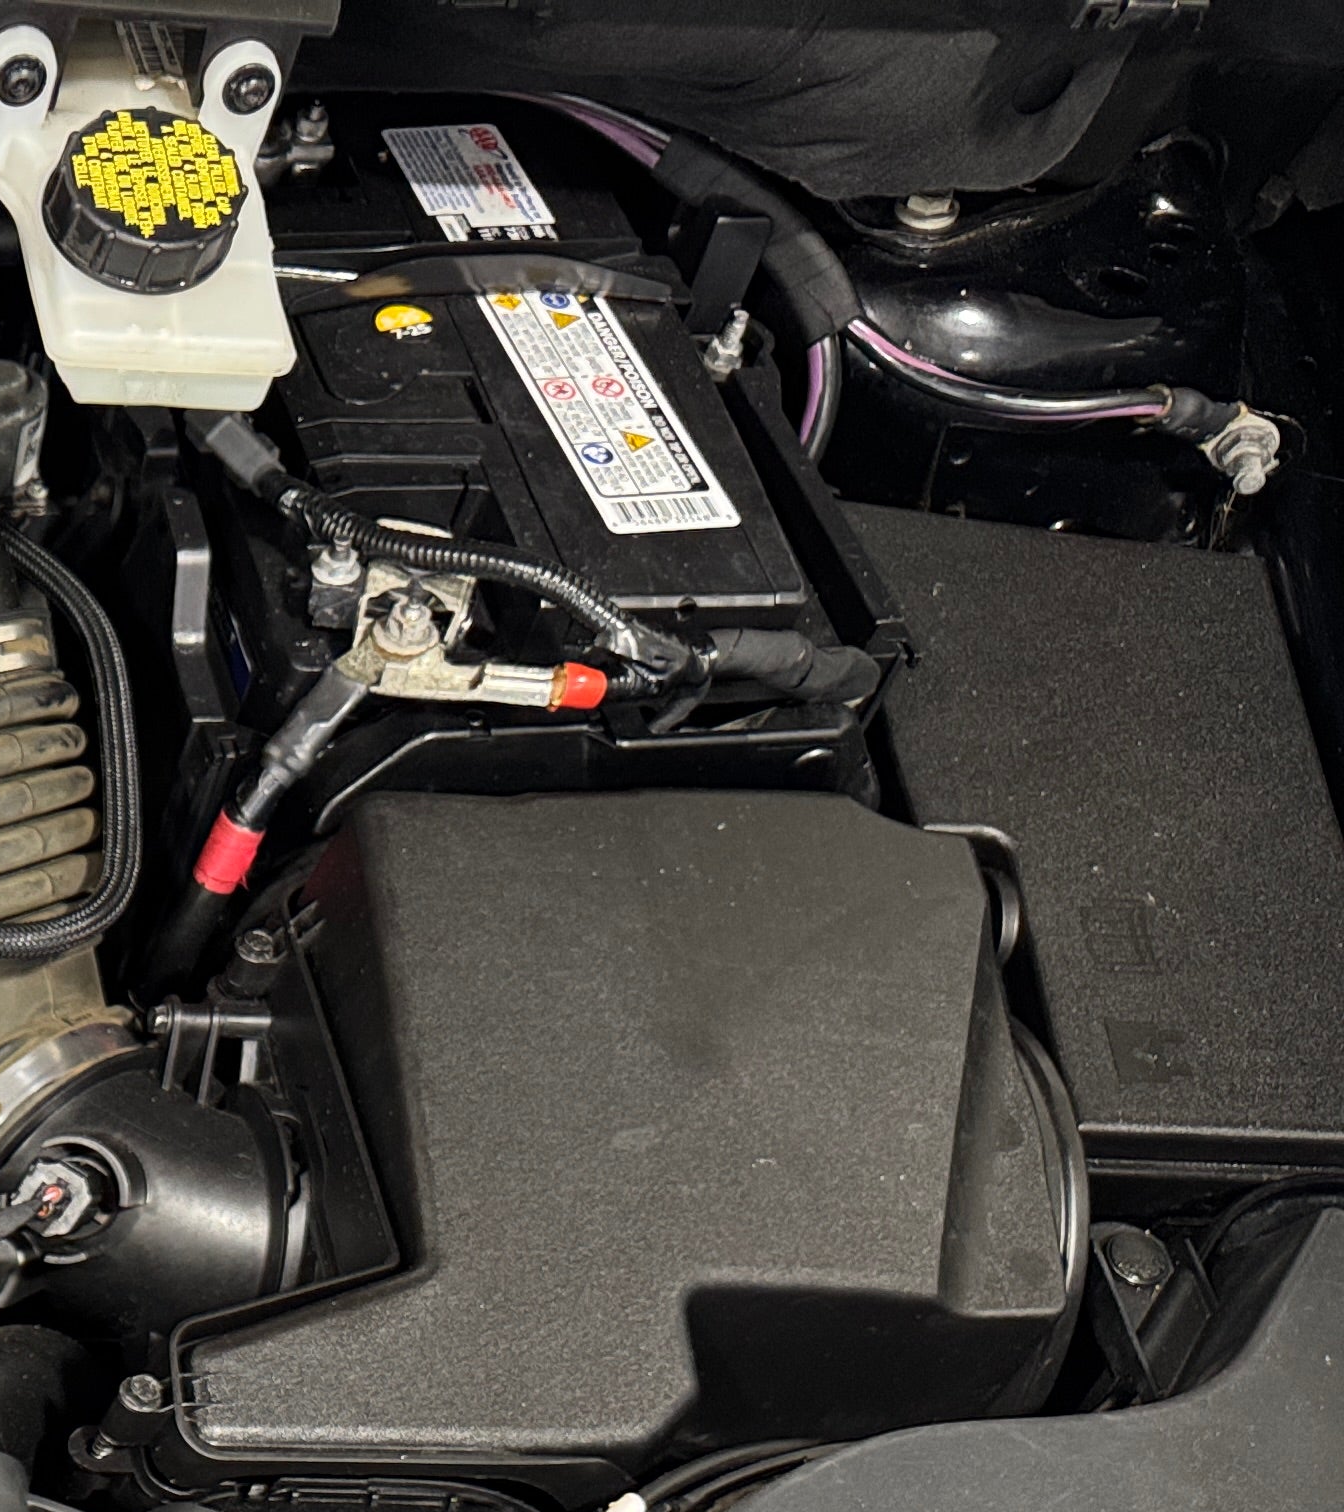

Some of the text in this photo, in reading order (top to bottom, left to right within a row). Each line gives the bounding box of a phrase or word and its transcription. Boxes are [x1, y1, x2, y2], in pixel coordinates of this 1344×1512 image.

[94, 132, 111, 150] DOT
[123, 139, 139, 152] DE
[126, 153, 142, 167] LE
[163, 135, 183, 168] SEALED
[178, 143, 194, 161] DOT
[142, 165, 157, 179] LE
[202, 133, 232, 216] CLEAN FILLER CAP
[184, 173, 202, 200] FLUID
[204, 206, 221, 227] USE
[585, 311, 659, 409] DANGER/POISON
